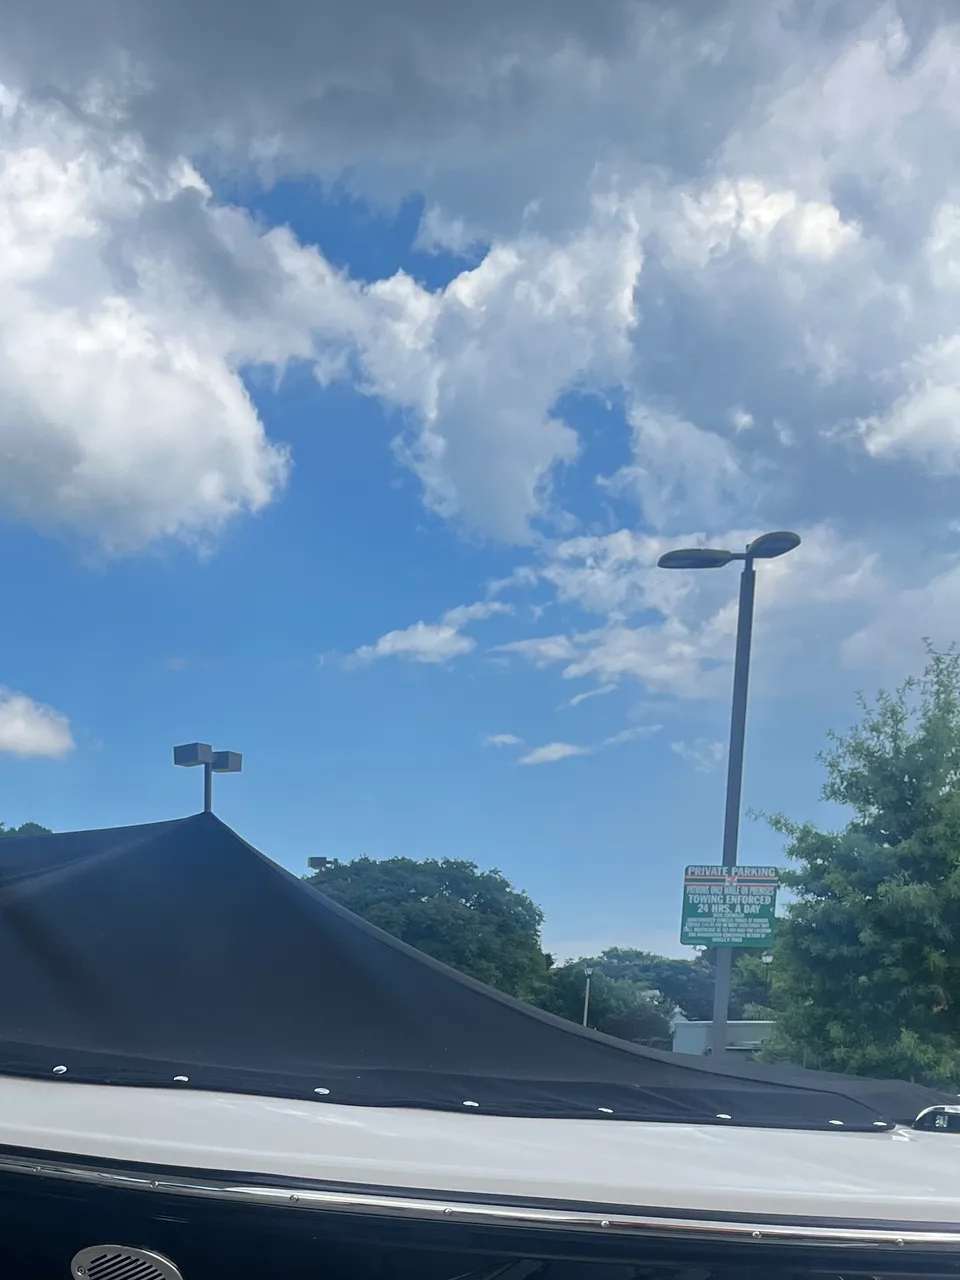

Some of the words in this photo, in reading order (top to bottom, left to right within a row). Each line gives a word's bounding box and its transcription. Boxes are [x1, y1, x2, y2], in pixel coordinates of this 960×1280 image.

[687, 866, 729, 876] PRIVATE
[731, 867, 776, 877] PARKING
[710, 886, 723, 895] ONLY
[688, 895, 724, 904] TOWING
[725, 895, 772, 905] ENFORCED
[697, 904, 709, 913] 24
[711, 904, 732, 914] HRS.
[735, 904, 741, 914] A
[743, 904, 761, 914] DAY
